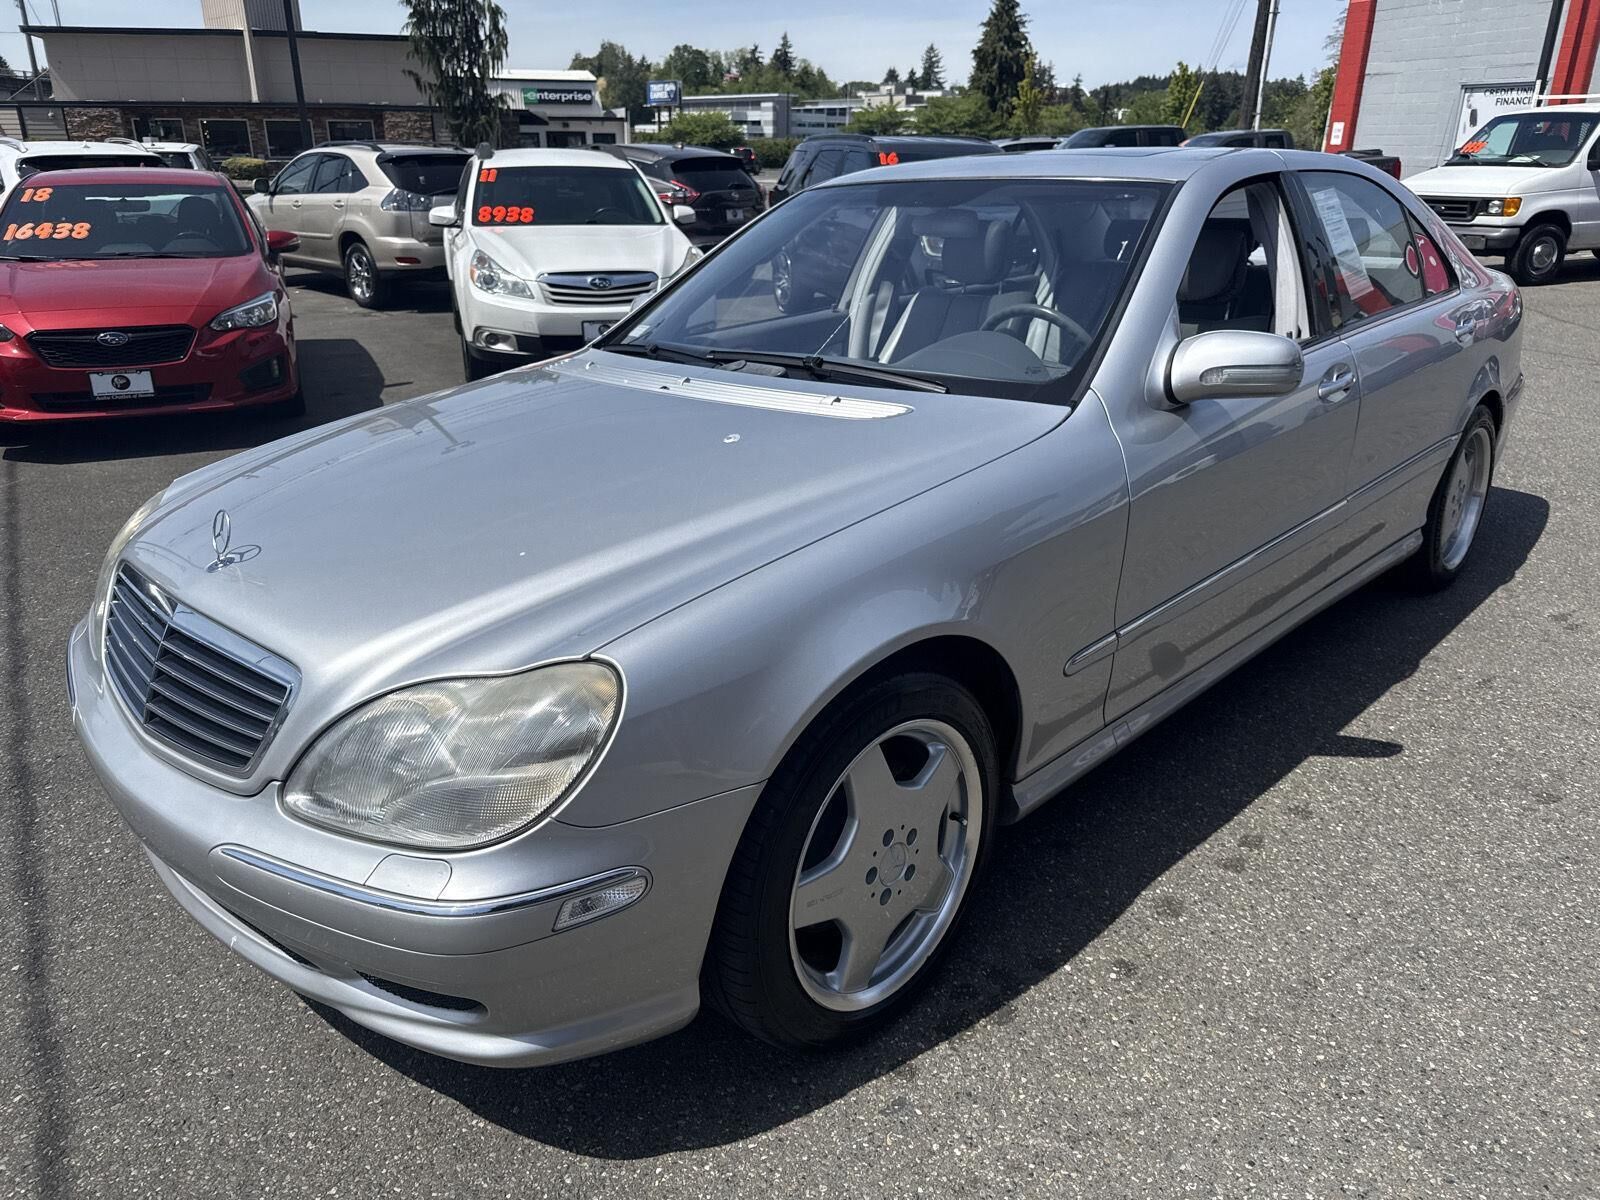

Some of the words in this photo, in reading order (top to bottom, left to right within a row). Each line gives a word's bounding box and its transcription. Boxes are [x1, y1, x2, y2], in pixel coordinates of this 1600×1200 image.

[525, 89, 592, 102] enterprise
[1484, 87, 1515, 97] CREDIT
[879, 152, 898, 165] 16
[480, 169, 497, 182] 11
[20, 187, 54, 203] 18
[478, 205, 535, 223] 8938
[3, 222, 92, 241] 16438
